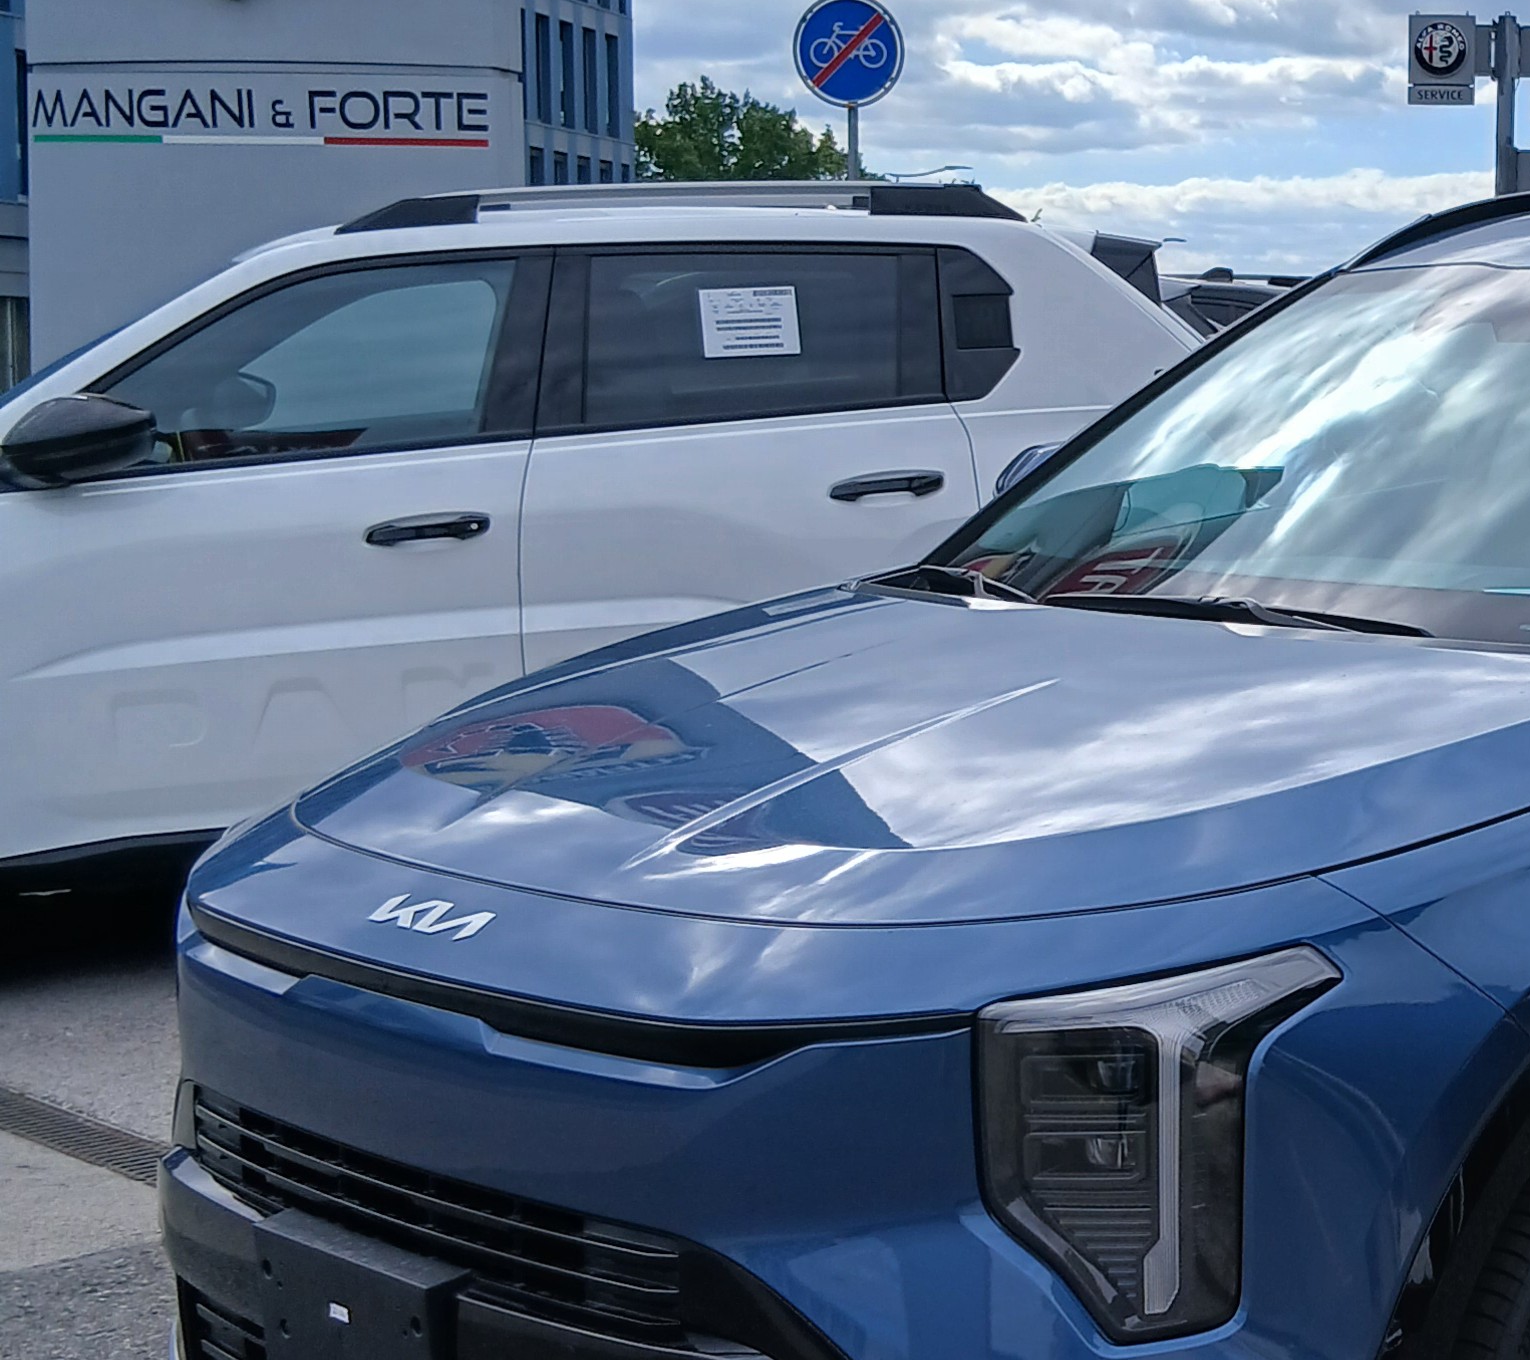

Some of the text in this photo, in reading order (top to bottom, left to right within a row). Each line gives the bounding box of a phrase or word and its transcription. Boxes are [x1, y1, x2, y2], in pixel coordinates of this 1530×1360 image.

[1437, 24, 1466, 52] ROMEO
[32, 87, 489, 133] MANGANI & FORTE
[1417, 89, 1464, 101] SERVICE
[368, 893, 498, 942] KIA
